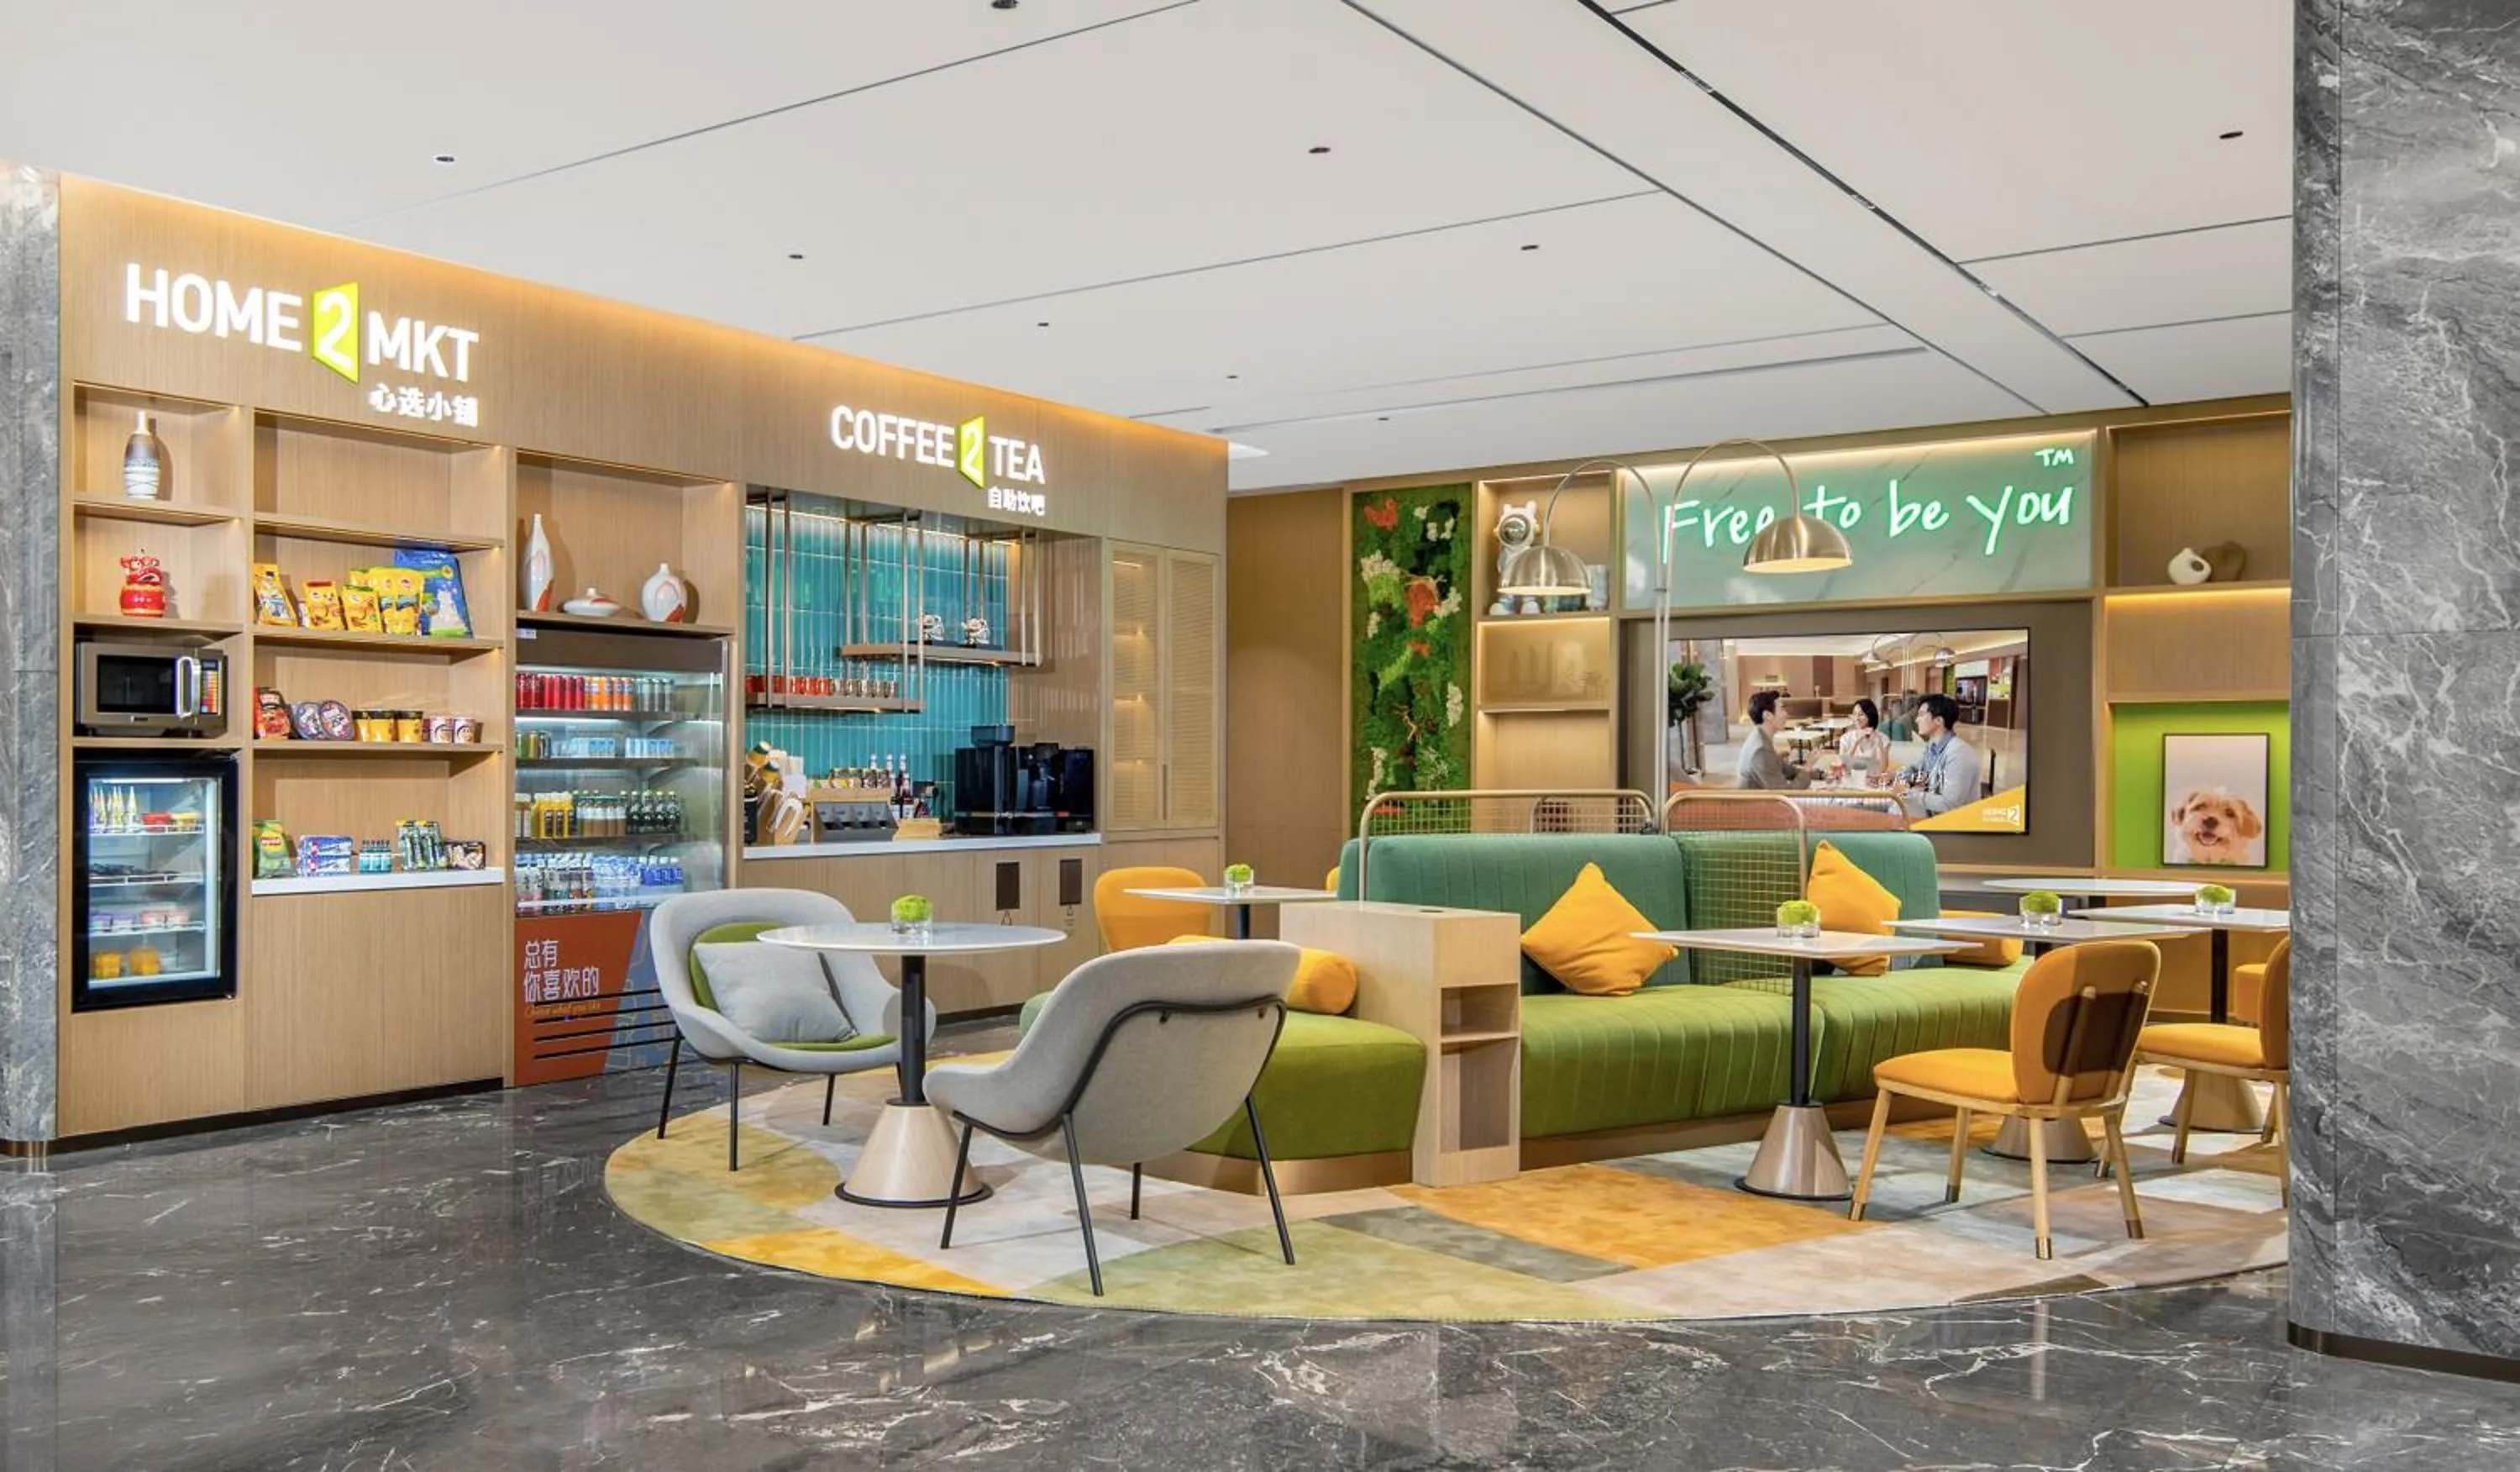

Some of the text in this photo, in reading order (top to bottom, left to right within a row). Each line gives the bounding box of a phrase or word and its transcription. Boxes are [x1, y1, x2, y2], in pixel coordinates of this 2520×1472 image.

[126, 263, 479, 381] HOME 2 MKT
[831, 405, 1045, 484] COFFEE 2 TEA
[988, 486, 1046, 517] 自助饮吧
[1662, 500, 1775, 564] Free
[1802, 485, 1861, 528] to
[1889, 480, 1950, 538] be
[524, 939, 559, 969] 总有
[524, 966, 600, 1002] 你喜欢的
